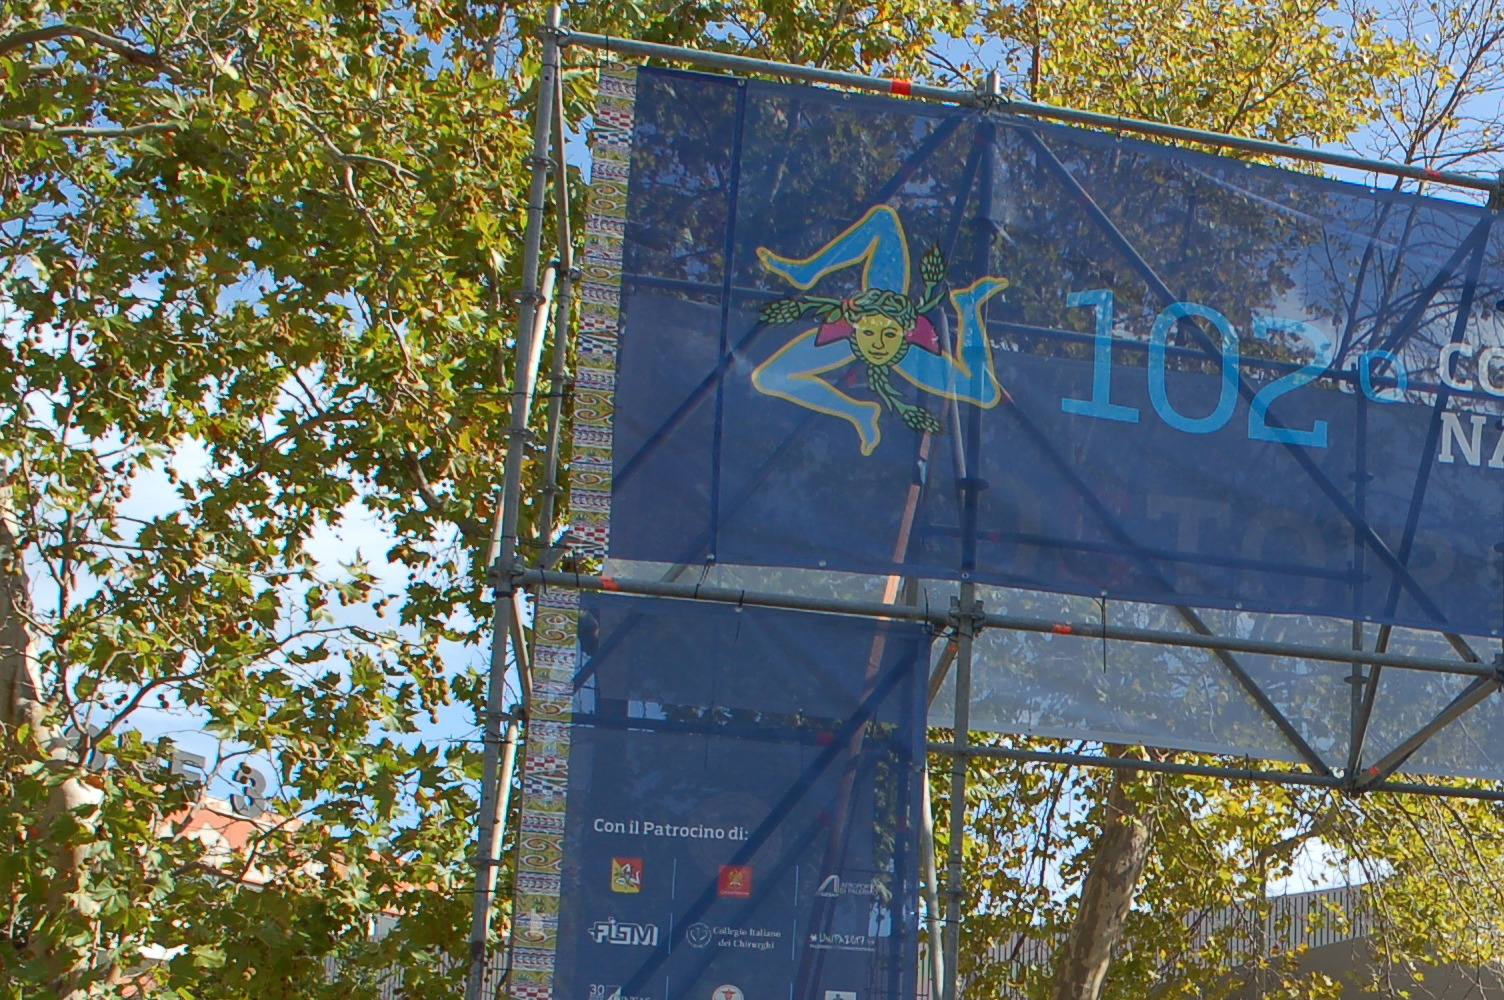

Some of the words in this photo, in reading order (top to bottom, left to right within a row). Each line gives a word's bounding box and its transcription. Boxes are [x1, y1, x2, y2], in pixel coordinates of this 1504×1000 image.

[593, 817, 626, 835] Con
[628, 819, 640, 836] il
[643, 821, 725, 840] Patrocino
[728, 825, 750, 842] di:
